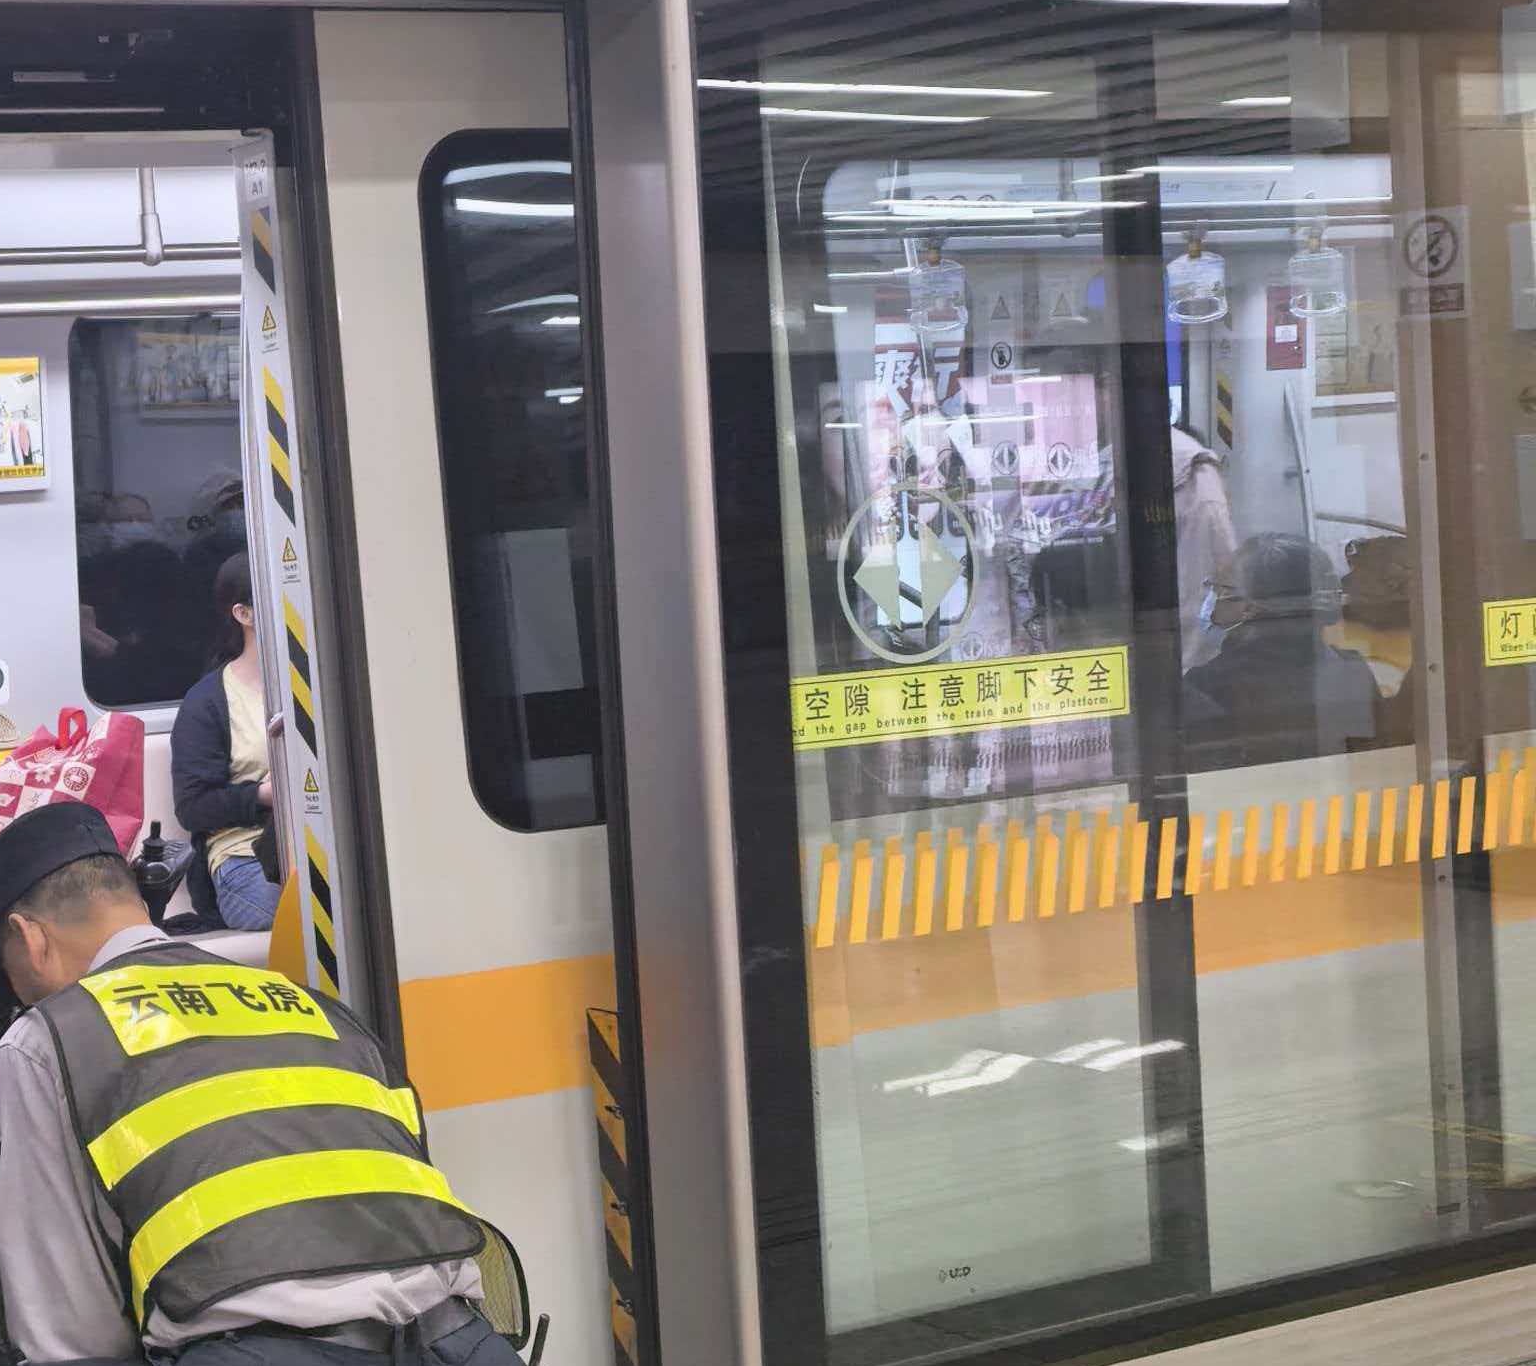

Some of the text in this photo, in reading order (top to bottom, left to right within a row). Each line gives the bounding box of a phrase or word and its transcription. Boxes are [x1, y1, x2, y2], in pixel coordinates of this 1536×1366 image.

[805, 660, 1110, 721] 空隙 注意脚下安全
[815, 724, 835, 734] the
[845, 722, 866, 735] gap
[876, 715, 927, 728] between
[937, 710, 955, 722] the
[965, 707, 994, 719] train
[1003, 703, 1023, 715] and
[1032, 700, 1051, 712] the
[112, 981, 316, 1023] 云南飞虎
